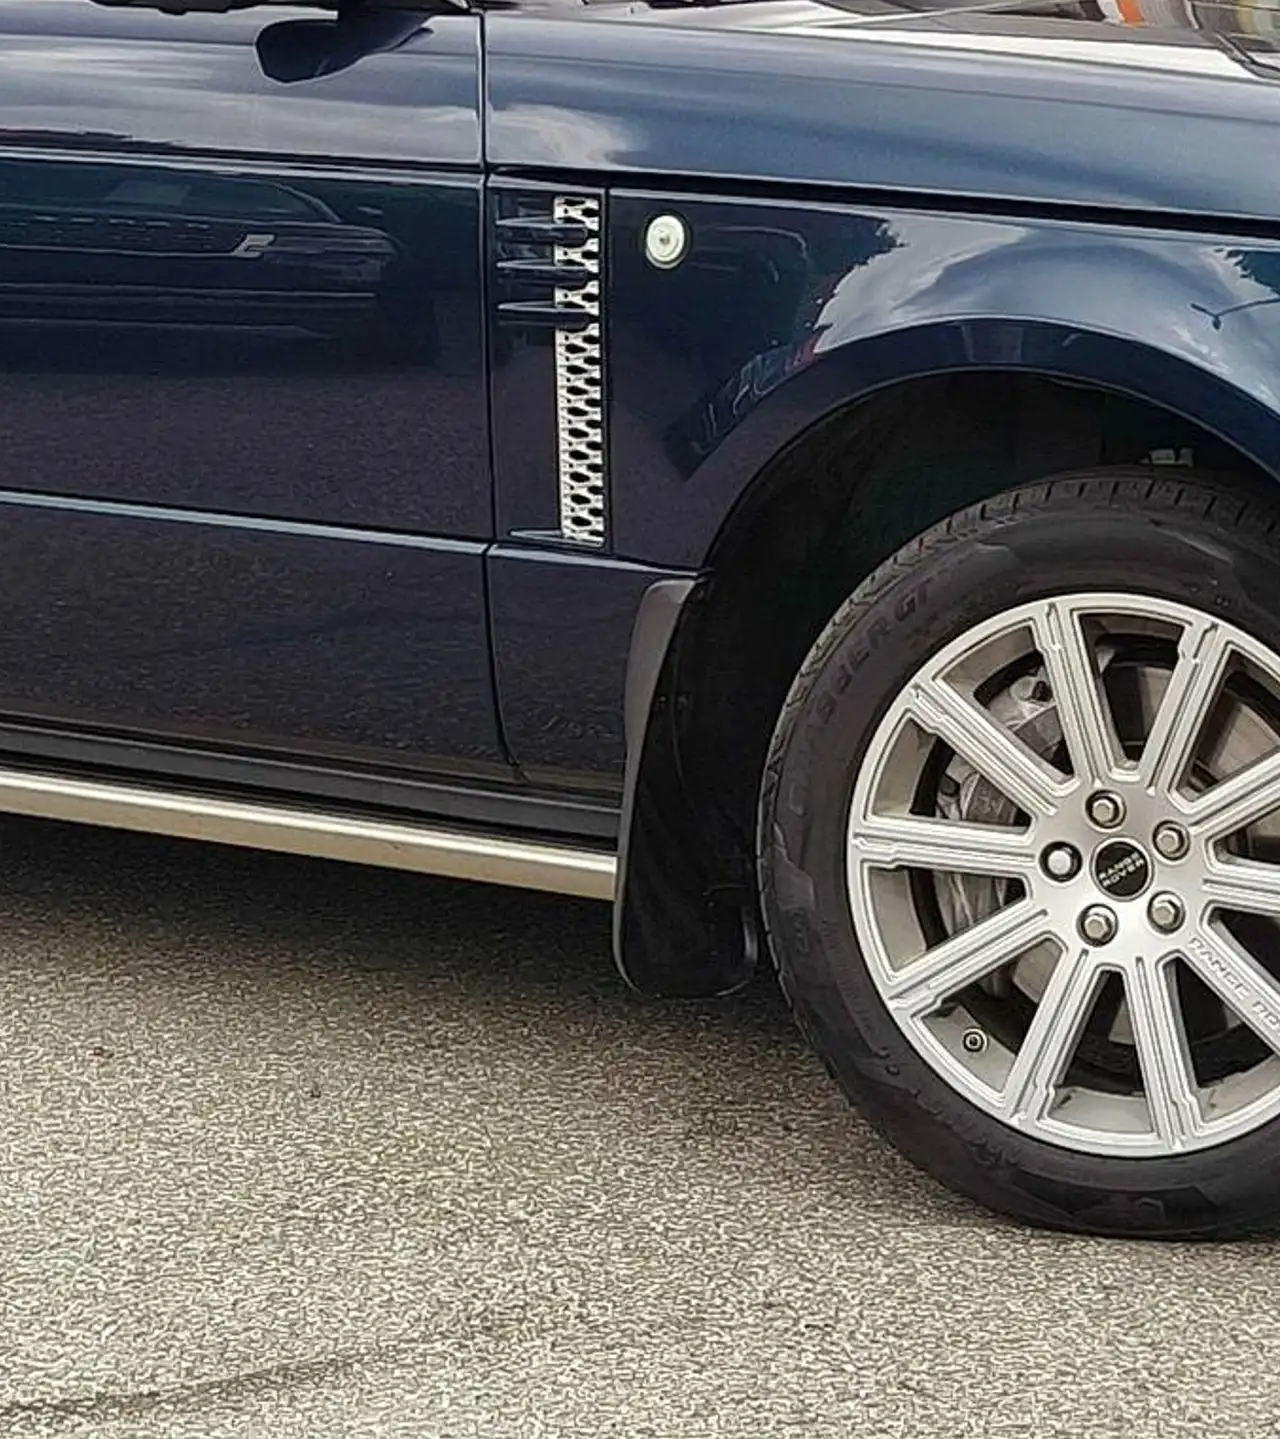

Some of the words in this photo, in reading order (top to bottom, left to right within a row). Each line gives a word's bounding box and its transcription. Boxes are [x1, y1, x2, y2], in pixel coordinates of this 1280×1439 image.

[1099, 851, 1140, 880] RANGE
[1102, 858, 1145, 888] ROVER
[1187, 936, 1251, 1000] RANGE
